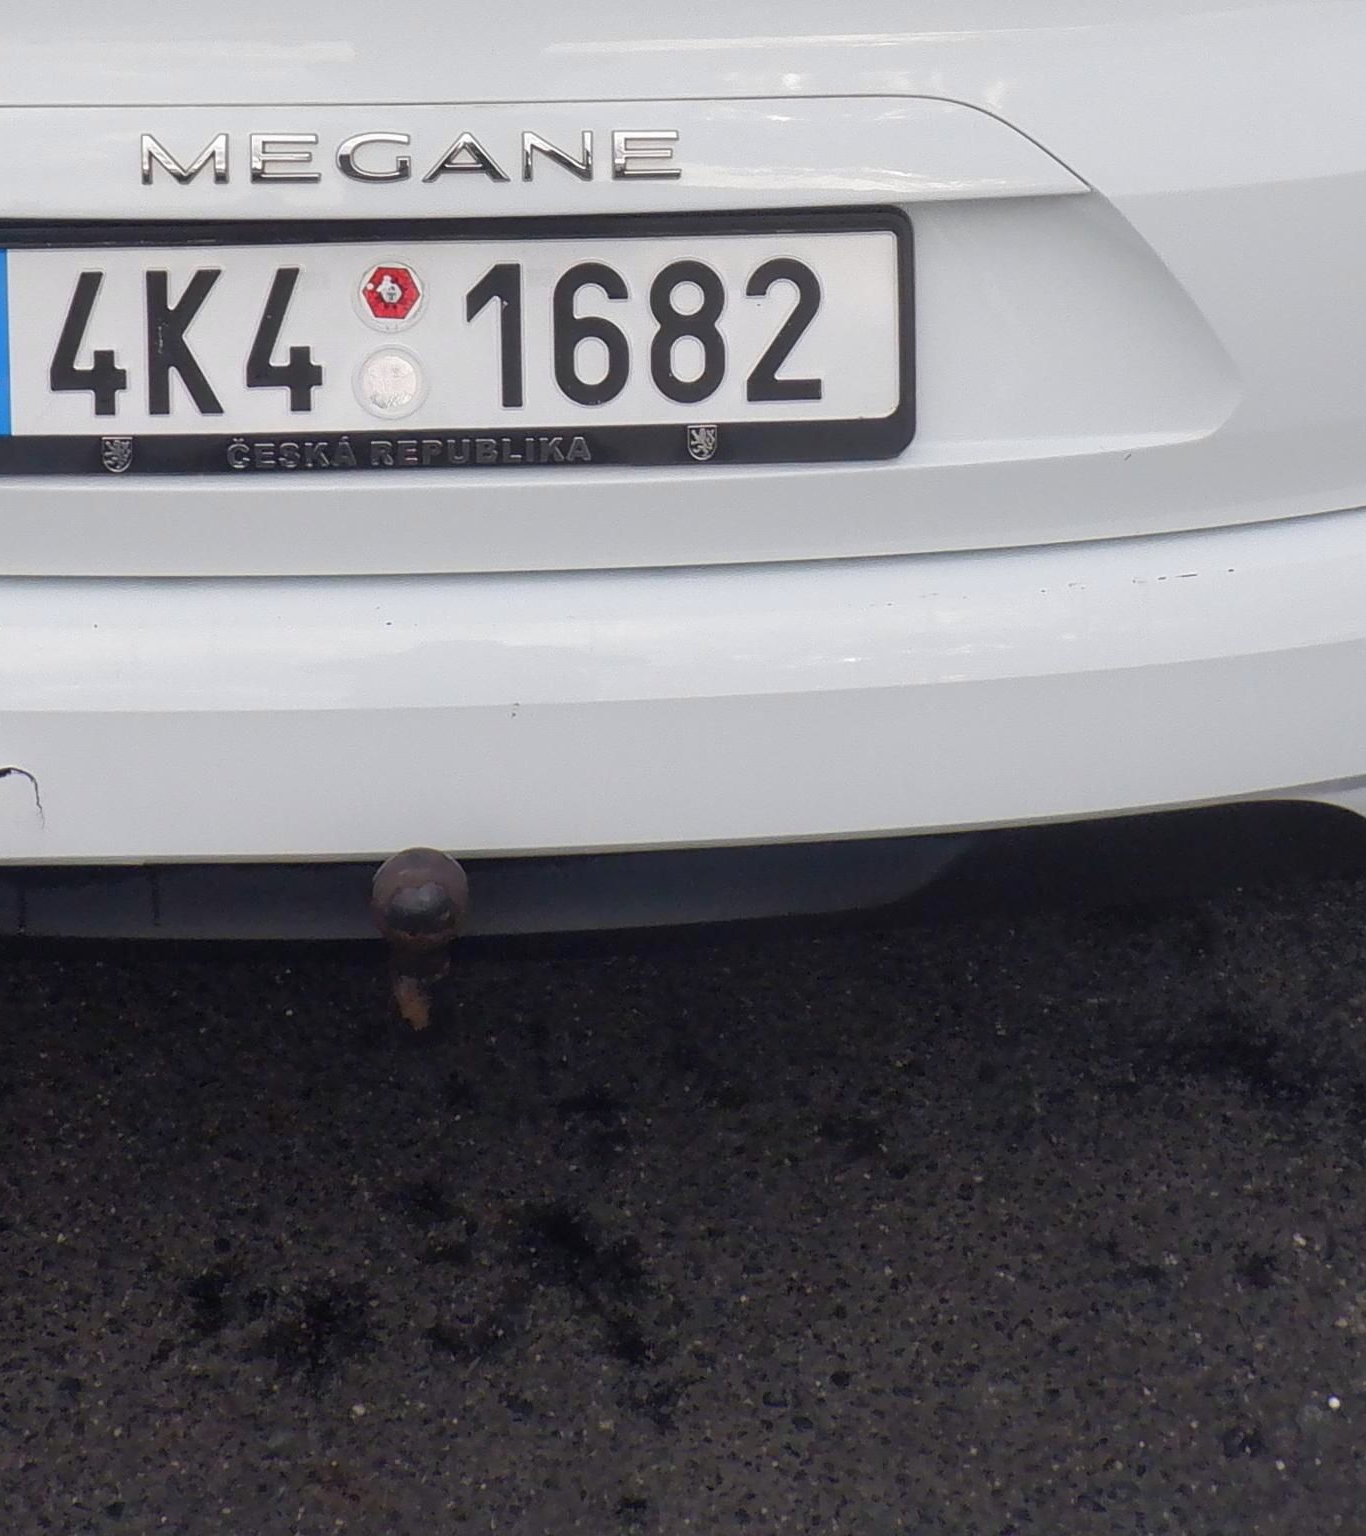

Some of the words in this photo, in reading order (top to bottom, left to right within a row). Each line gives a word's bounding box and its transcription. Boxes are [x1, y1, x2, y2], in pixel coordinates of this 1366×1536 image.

[140, 131, 682, 185] MEGANE
[49, 268, 324, 416] 4K4
[465, 258, 823, 408] 1682
[226, 436, 357, 469] ČESKÁ
[370, 436, 592, 466] REPUBLIKA
